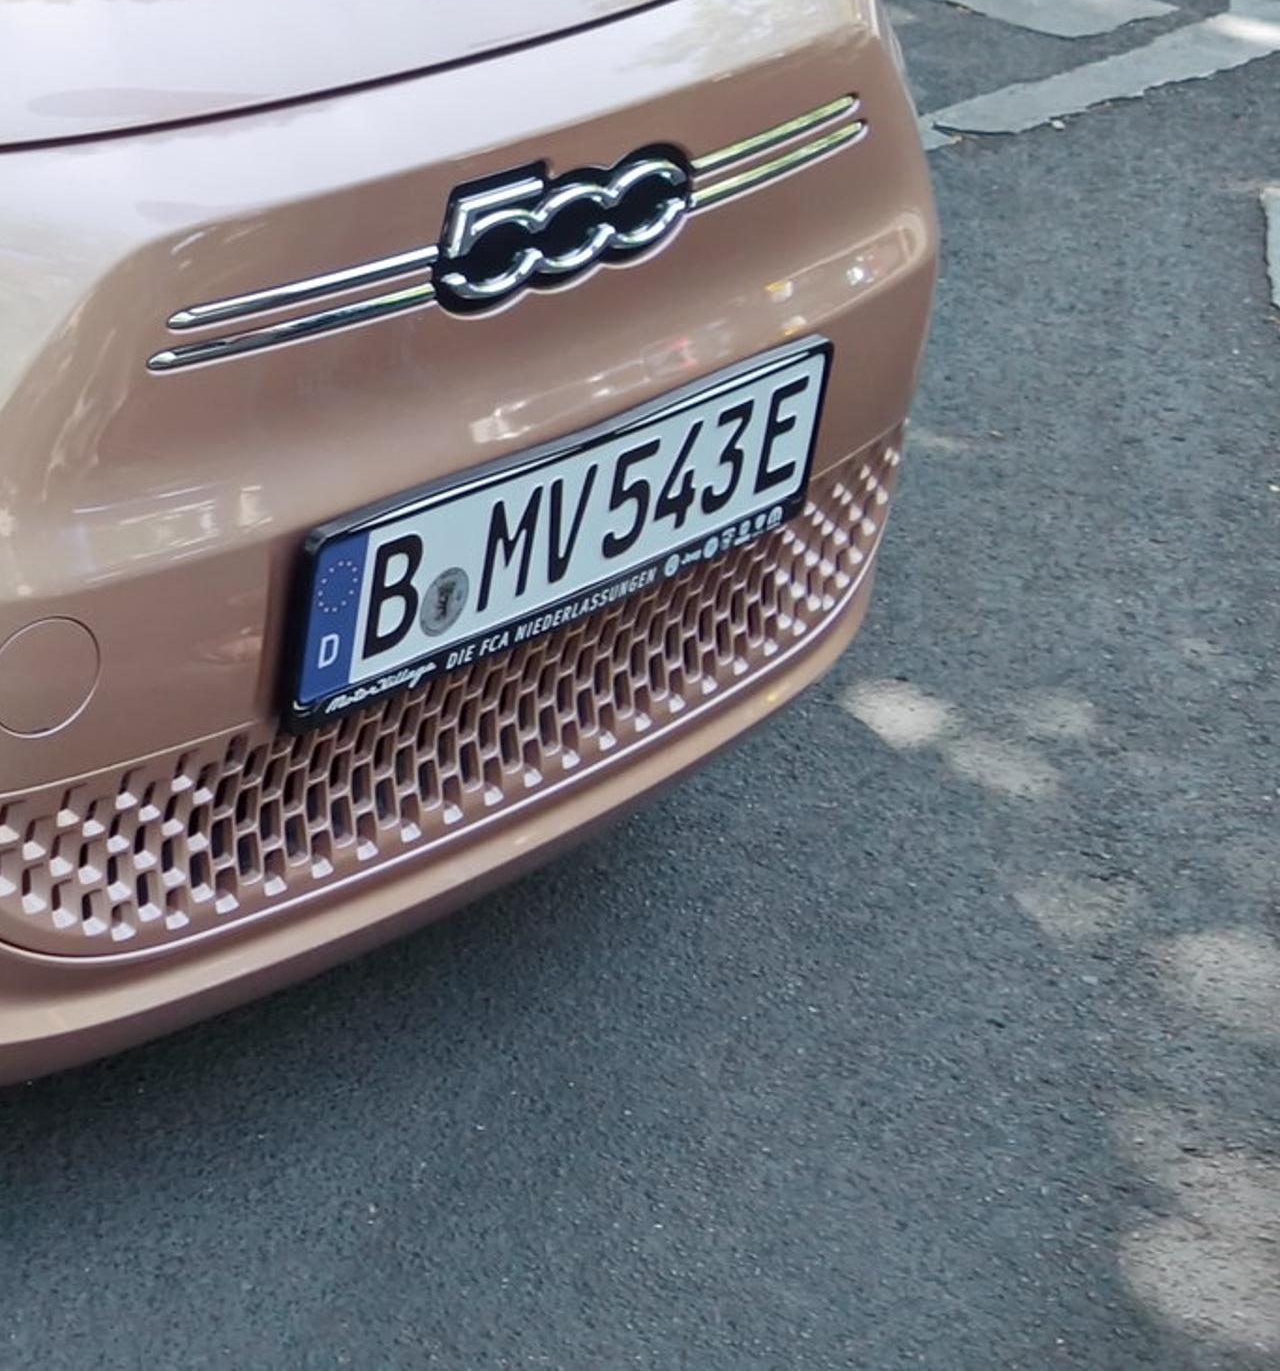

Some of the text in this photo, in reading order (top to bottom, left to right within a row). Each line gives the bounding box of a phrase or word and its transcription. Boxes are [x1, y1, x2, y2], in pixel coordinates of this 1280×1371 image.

[439, 152, 690, 308] 500
[318, 633, 340, 669] D
[361, 532, 423, 660] B
[446, 644, 476, 670] DIE
[479, 632, 509, 657] FCA
[514, 567, 658, 642] NIEDERLASSUNGEN
